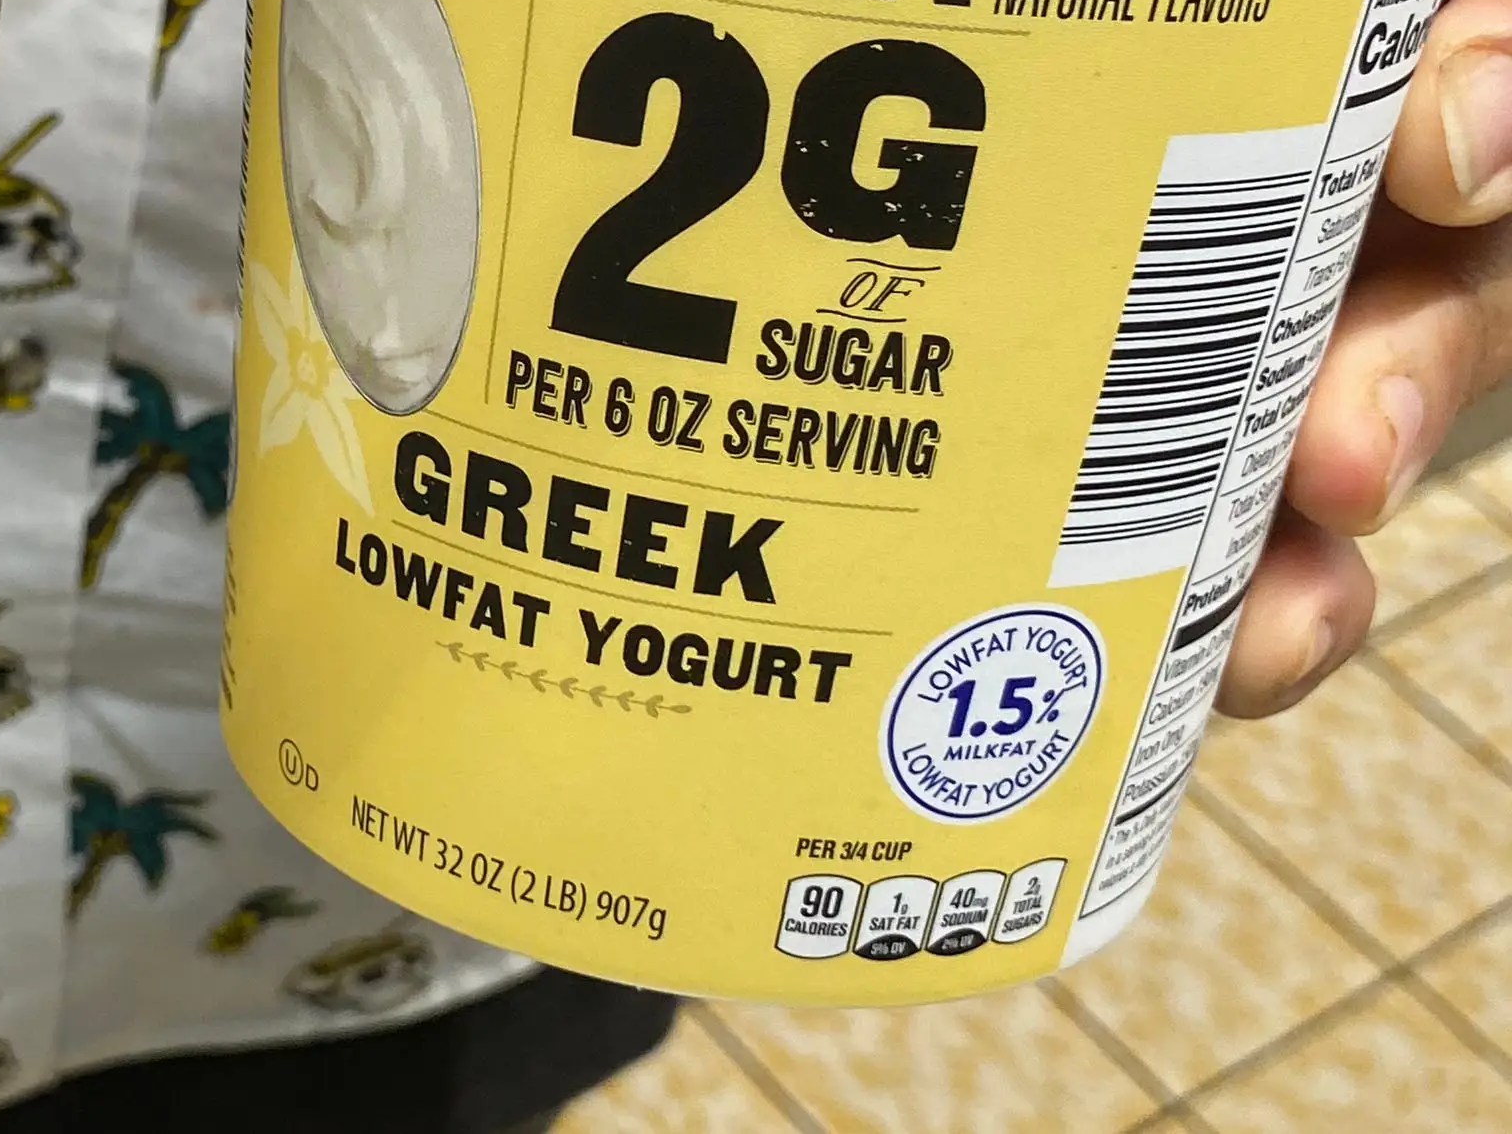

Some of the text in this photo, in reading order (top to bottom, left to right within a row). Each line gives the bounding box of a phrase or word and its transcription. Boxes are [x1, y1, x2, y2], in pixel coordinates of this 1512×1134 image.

[1358, 10, 1433, 75] Calor
[549, 11, 986, 364] 2G
[1318, 163, 1357, 199] Total
[839, 270, 925, 312] OF
[756, 318, 953, 396] SUGAR
[1255, 354, 1306, 392] Sodium
[505, 349, 941, 479] PER 6 OZ SERVING
[1242, 401, 1281, 437] Total
[394, 430, 785, 605] GREEK
[335, 517, 551, 647] LOWFAT
[579, 608, 853, 703] YOGURT
[1183, 576, 1233, 616] Protein
[917, 627, 1087, 703] LOWFAT YOGURT
[948, 676, 1065, 738] 1.5%
[902, 729, 1070, 807] LOWFAT YOGURT
[943, 740, 1037, 761] MILKFAT
[351, 795, 667, 940] NET WT 32 OZ (2 LB) 907g
[795, 837, 912, 861] PER 3/4 CUP
[800, 884, 843, 919] 90
[941, 909, 988, 928] SODIUM
[1013, 896, 1043, 915] TOTAL
[785, 918, 848, 937] CALORIES
[869, 915, 920, 931] SAT FAT
[1002, 911, 1045, 933] SUGARS
[890, 941, 906, 954] DV
